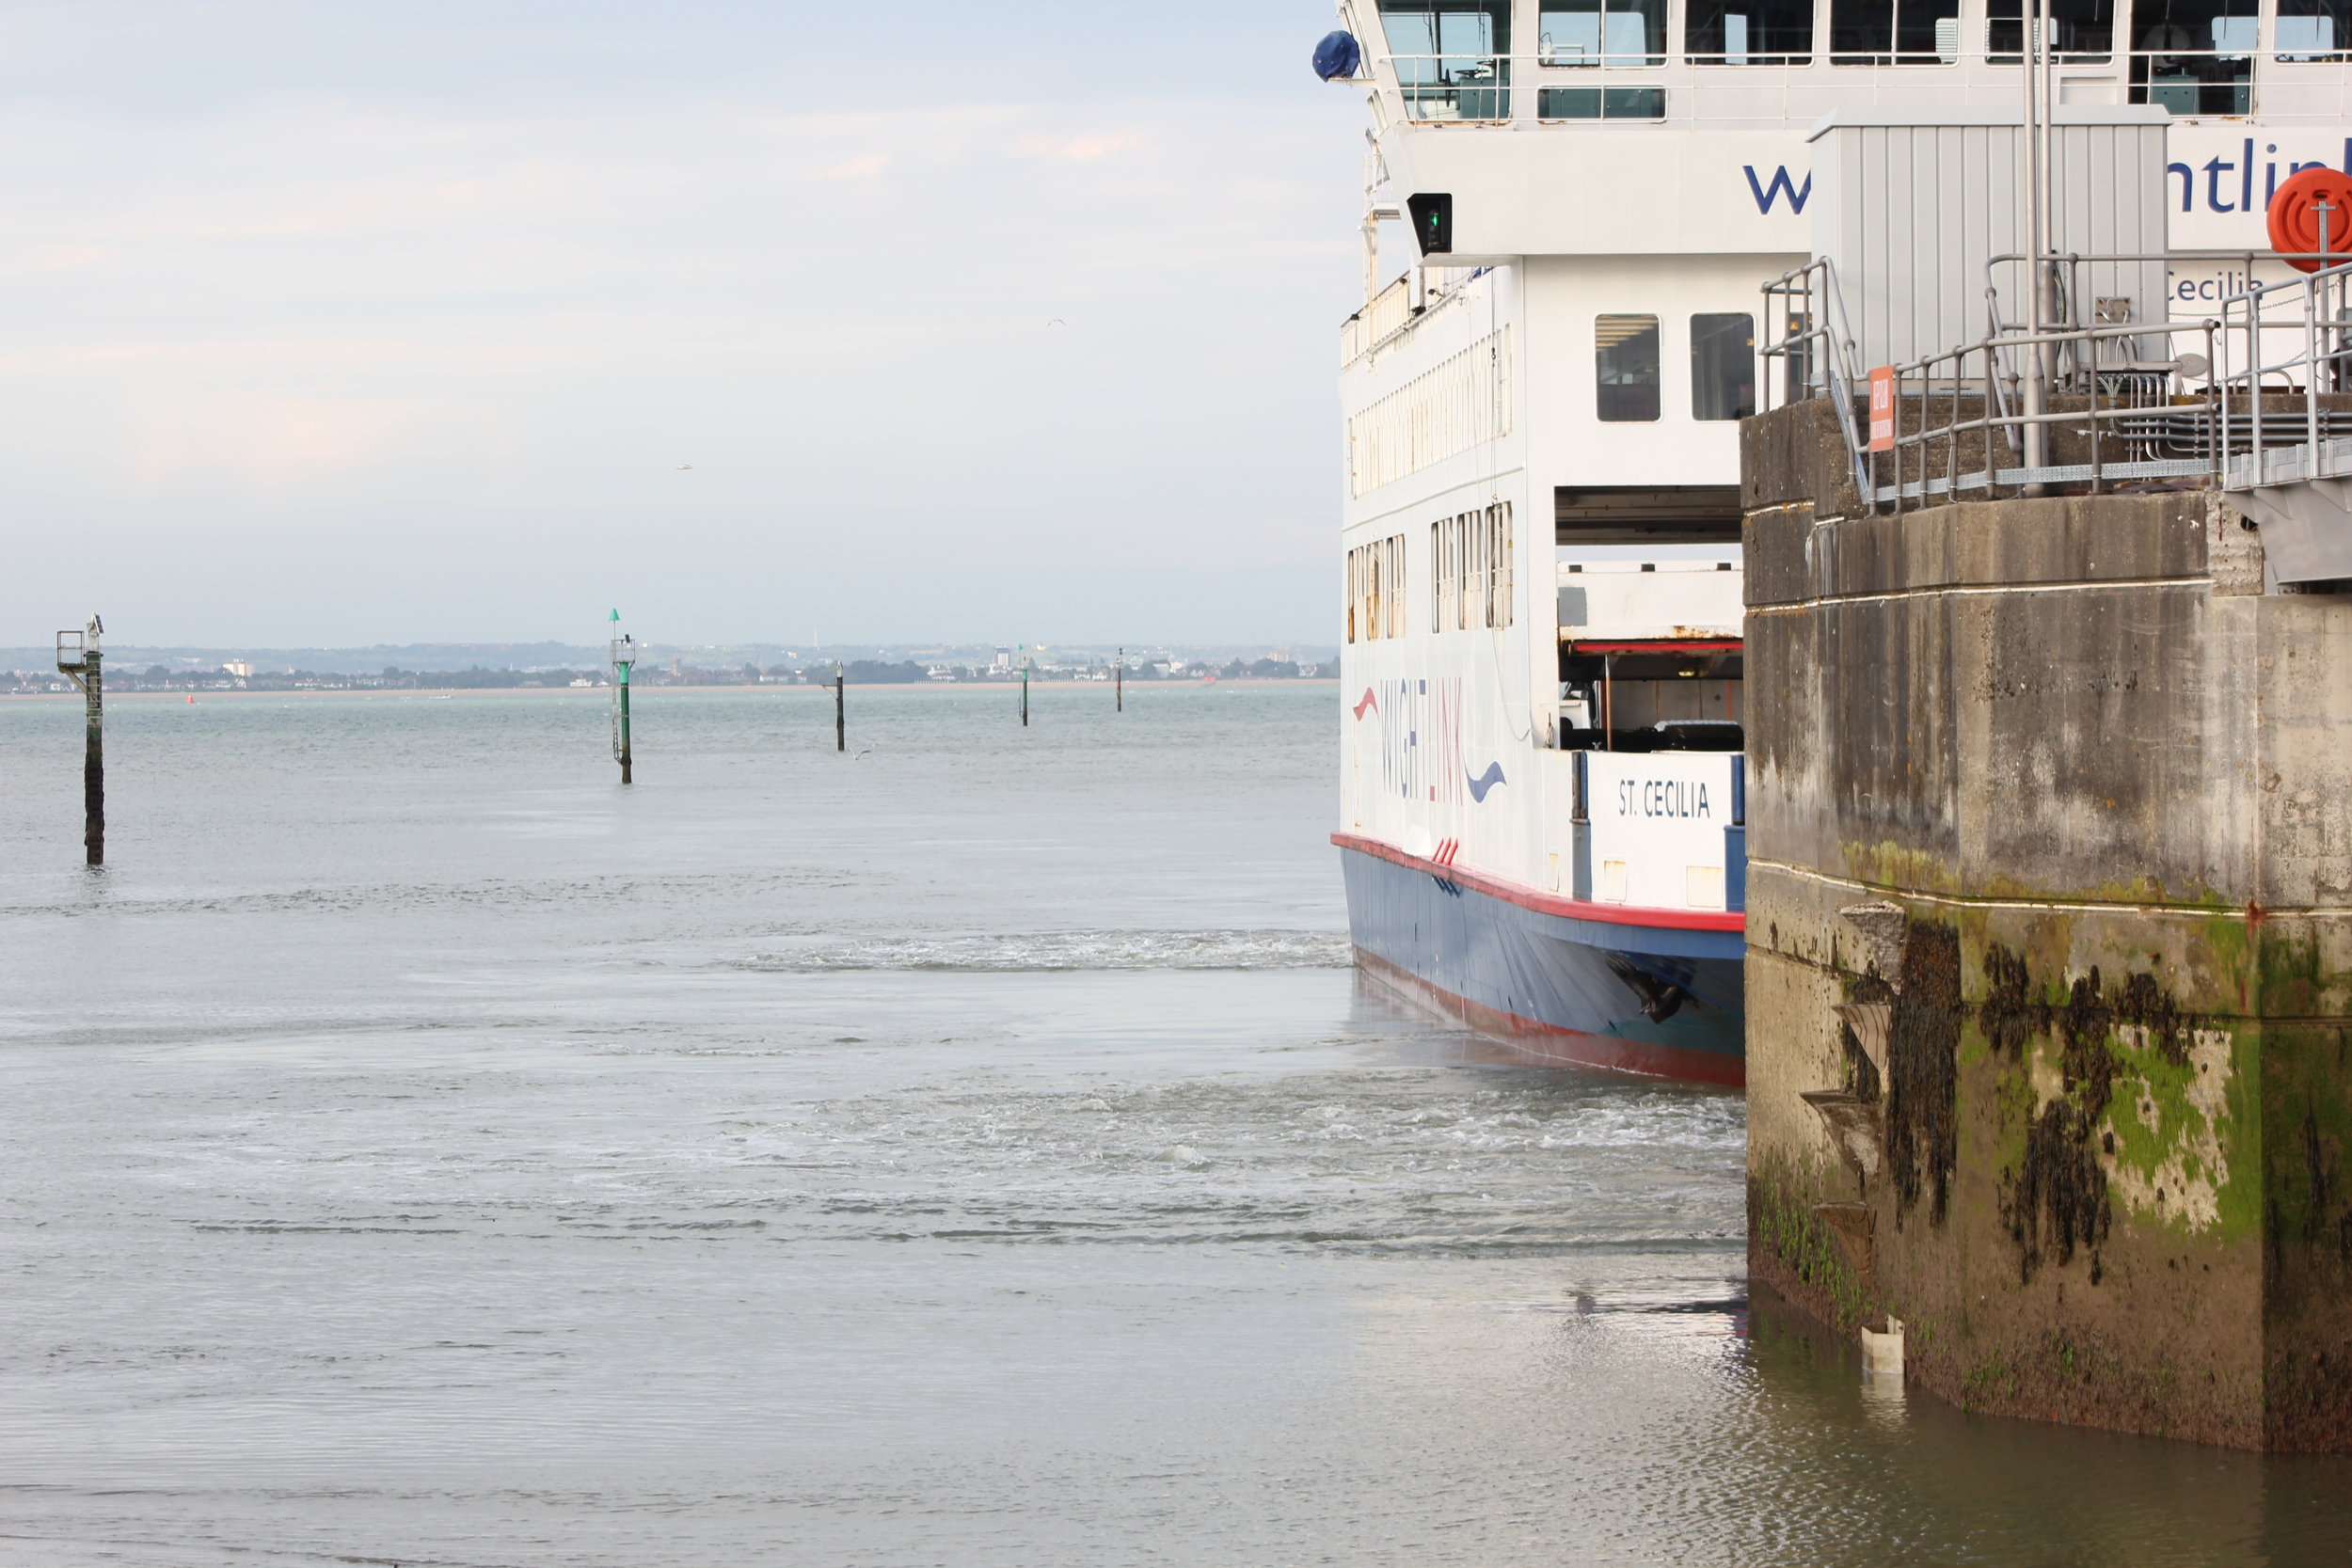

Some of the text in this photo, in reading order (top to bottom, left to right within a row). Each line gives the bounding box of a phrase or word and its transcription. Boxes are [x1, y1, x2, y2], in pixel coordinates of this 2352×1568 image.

[1380, 677, 1464, 807] WIGHTLINK
[1619, 779, 1710, 818] ST. CECILIA
